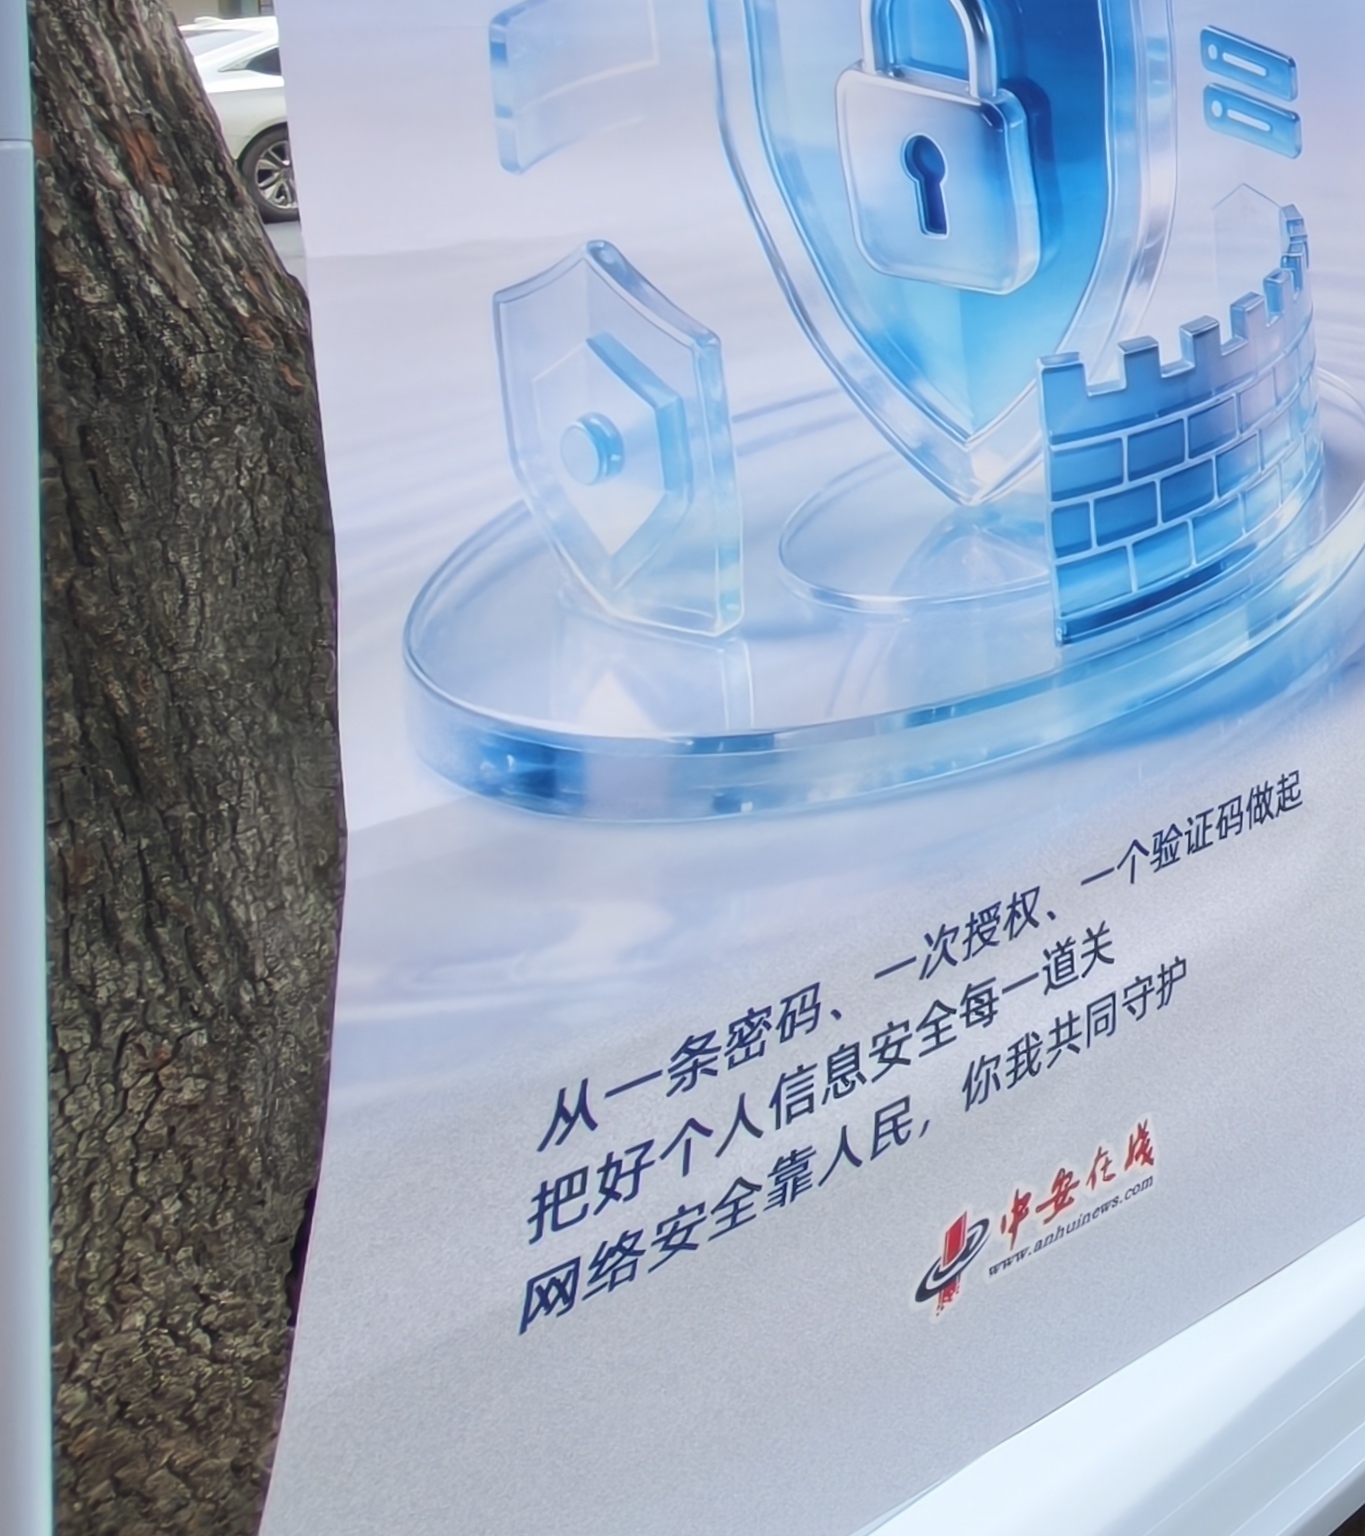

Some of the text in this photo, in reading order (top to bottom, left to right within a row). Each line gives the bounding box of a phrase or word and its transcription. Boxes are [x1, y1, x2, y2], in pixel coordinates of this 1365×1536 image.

[537, 768, 1304, 1153] 从一条密码、一次授权、一个验证码做起
[528, 921, 1116, 1245] 把好个人信息安全每一道关
[1001, 1119, 1154, 1251] 中安在线
[988, 1176, 1154, 1279] www.anhuinews.com
